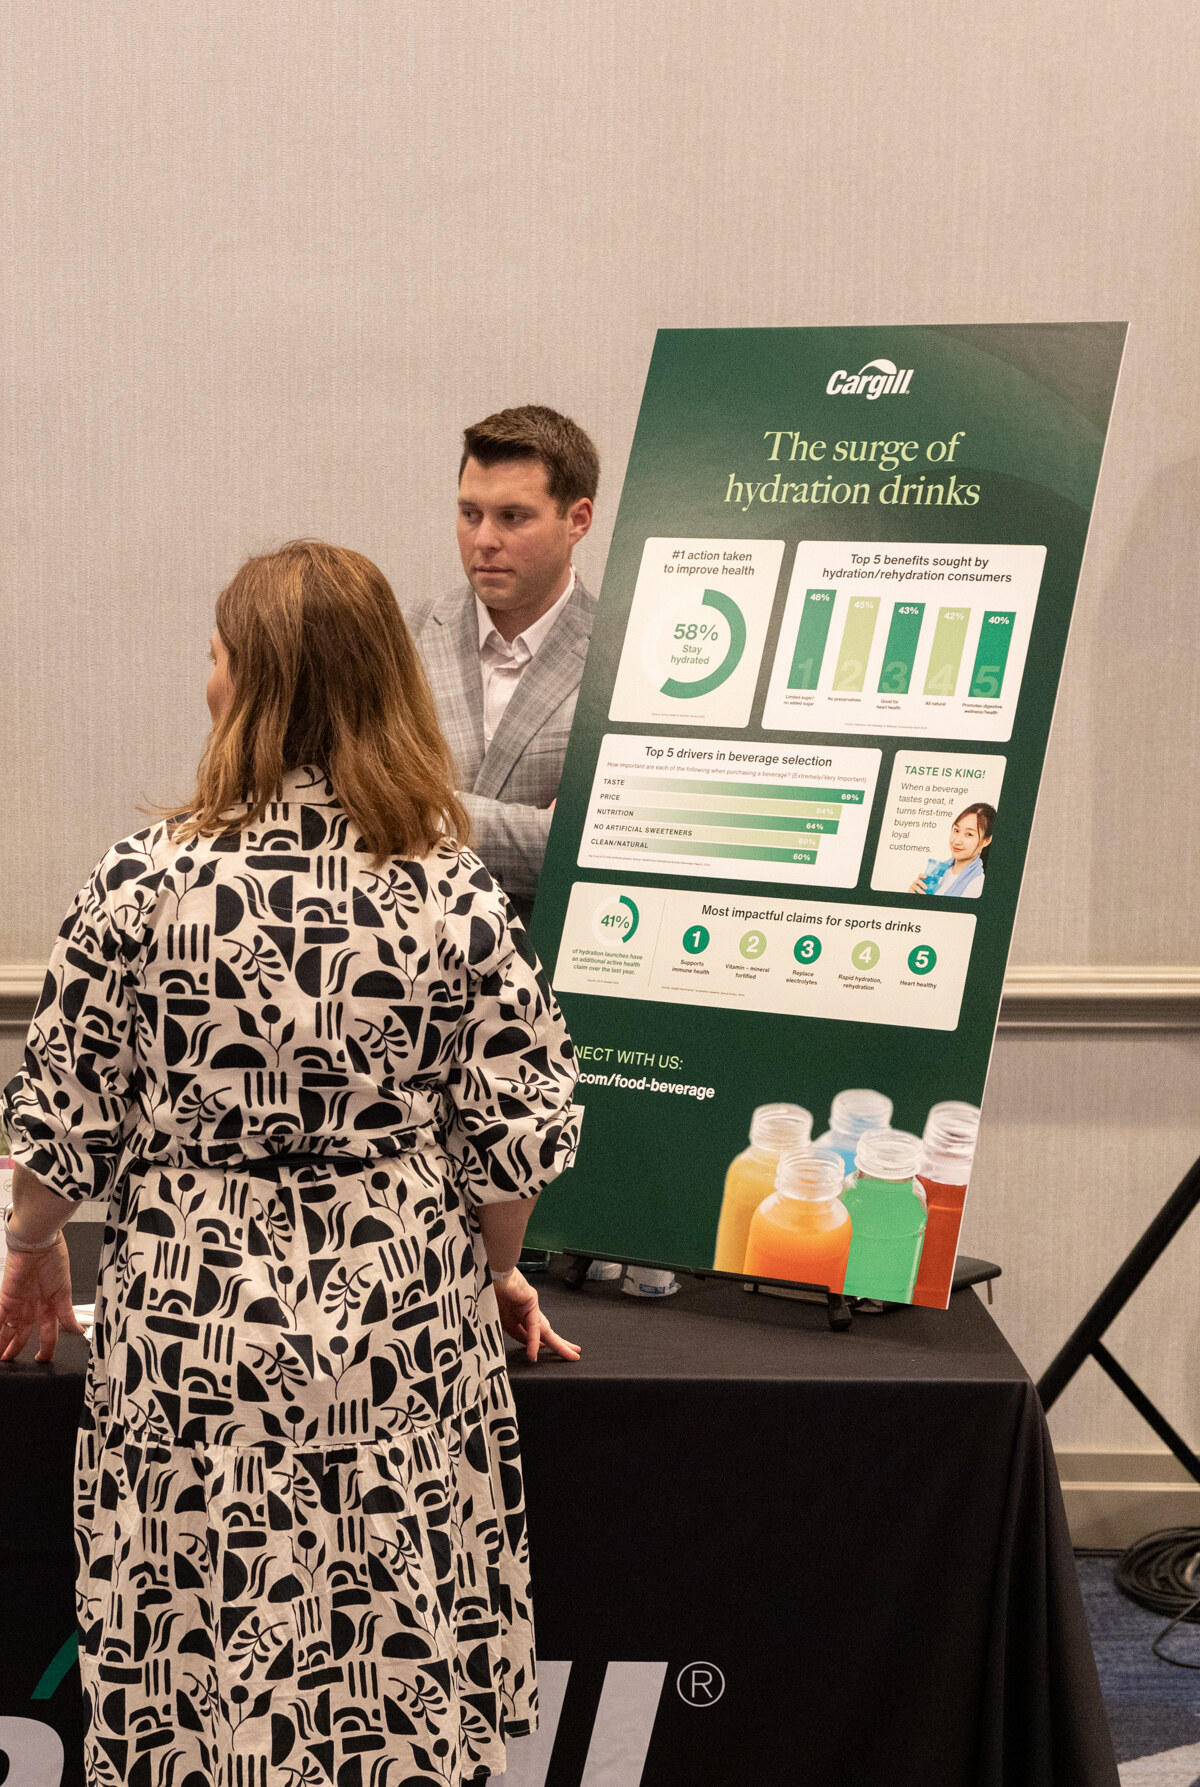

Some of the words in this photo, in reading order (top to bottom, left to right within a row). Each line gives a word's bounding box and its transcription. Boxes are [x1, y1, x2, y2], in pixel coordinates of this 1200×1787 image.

[826, 369, 915, 400] Cargill
[763, 431, 826, 460] The
[832, 440, 918, 471] surge
[926, 431, 965, 461] of
[723, 473, 869, 511] hydration
[879, 474, 982, 511] drinks
[672, 550, 685, 559] #1
[687, 551, 719, 560] action
[722, 551, 752, 561] taken
[851, 554, 870, 566] Top
[873, 554, 880, 564] 5
[883, 554, 929, 565] benefits
[932, 556, 971, 568] sought
[974, 556, 989, 569] by
[663, 564, 673, 573] to
[676, 563, 719, 575] improve
[721, 565, 754, 575] health
[822, 567, 944, 581] hydration/rehydration
[947, 573, 1011, 582] consumers
[810, 593, 830, 602] 46%
[899, 606, 919, 615] 43%
[988, 616, 1009, 625] 40%
[673, 623, 719, 641] 58%
[682, 645, 703, 655] Stay
[670, 655, 710, 665] hydrated
[645, 746, 663, 758] Top
[666, 747, 674, 757] 5
[676, 748, 713, 759] drivers
[716, 750, 725, 760] in
[728, 751, 778, 765] beverage
[781, 755, 832, 766] selection
[905, 765, 939, 776] TASTE
[942, 768, 953, 777] IS
[955, 769, 986, 779] KING!
[603, 778, 625, 786] TASTE
[901, 782, 924, 791] When
[932, 785, 968, 796] beverage
[600, 793, 621, 801] PRICE
[841, 793, 859, 801] 69%
[899, 795, 922, 803] tastes
[924, 796, 946, 806] great,
[597, 808, 634, 817] NUTRITION
[897, 807, 916, 815] turns
[918, 808, 953, 818] first-time
[806, 822, 824, 831] 64%
[894, 818, 920, 829] buyers
[922, 820, 937, 829] into
[594, 823, 604, 831] NO
[605, 824, 643, 834] ARTIFICIAL
[645, 827, 693, 837] SWEETENERS
[892, 830, 910, 840] loyal
[591, 838, 649, 849] CLEAN/NATURAL
[889, 843, 932, 853] customers.
[793, 853, 811, 861] 60%
[601, 914, 630, 929] 41%
[701, 904, 730, 918] Most
[732, 906, 784, 922] impactful
[786, 910, 822, 925] claims
[826, 914, 842, 926] for
[845, 917, 881, 932] sports
[884, 920, 922, 934] drinks
[692, 931, 702, 948] 1
[746, 935, 759, 953] 2
[800, 940, 814, 957] 3
[858, 946, 872, 963] 4
[915, 950, 929, 968] 5
[617, 1050, 655, 1067] WITH
[659, 1055, 684, 1070] US:
